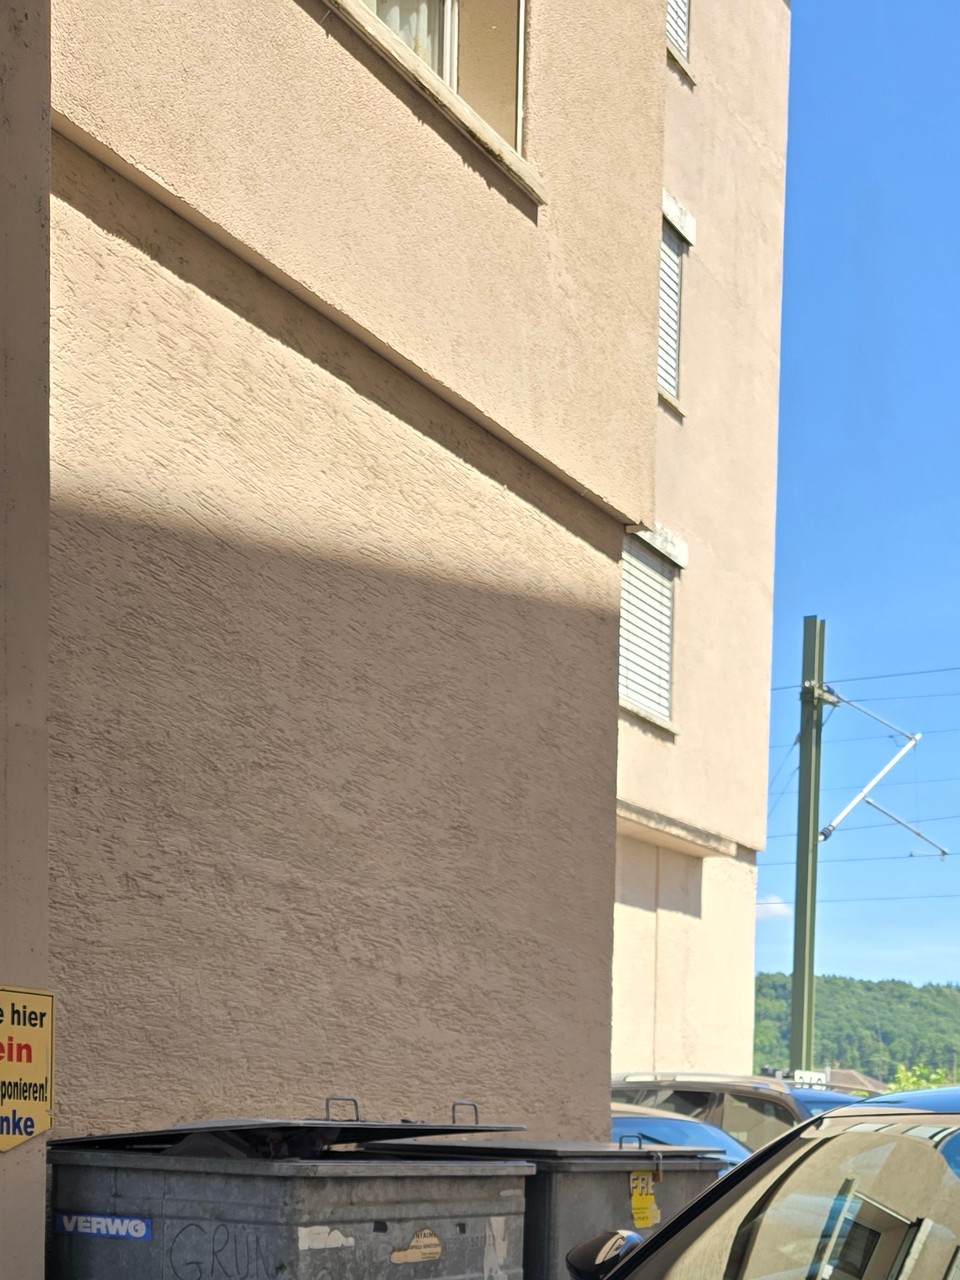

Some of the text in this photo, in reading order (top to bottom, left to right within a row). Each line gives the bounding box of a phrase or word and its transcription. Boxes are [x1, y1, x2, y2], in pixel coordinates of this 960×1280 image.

[11, 1003, 46, 1028] hier
[1, 1076, 47, 1106] ponieren!
[62, 1215, 147, 1238] VERWO
